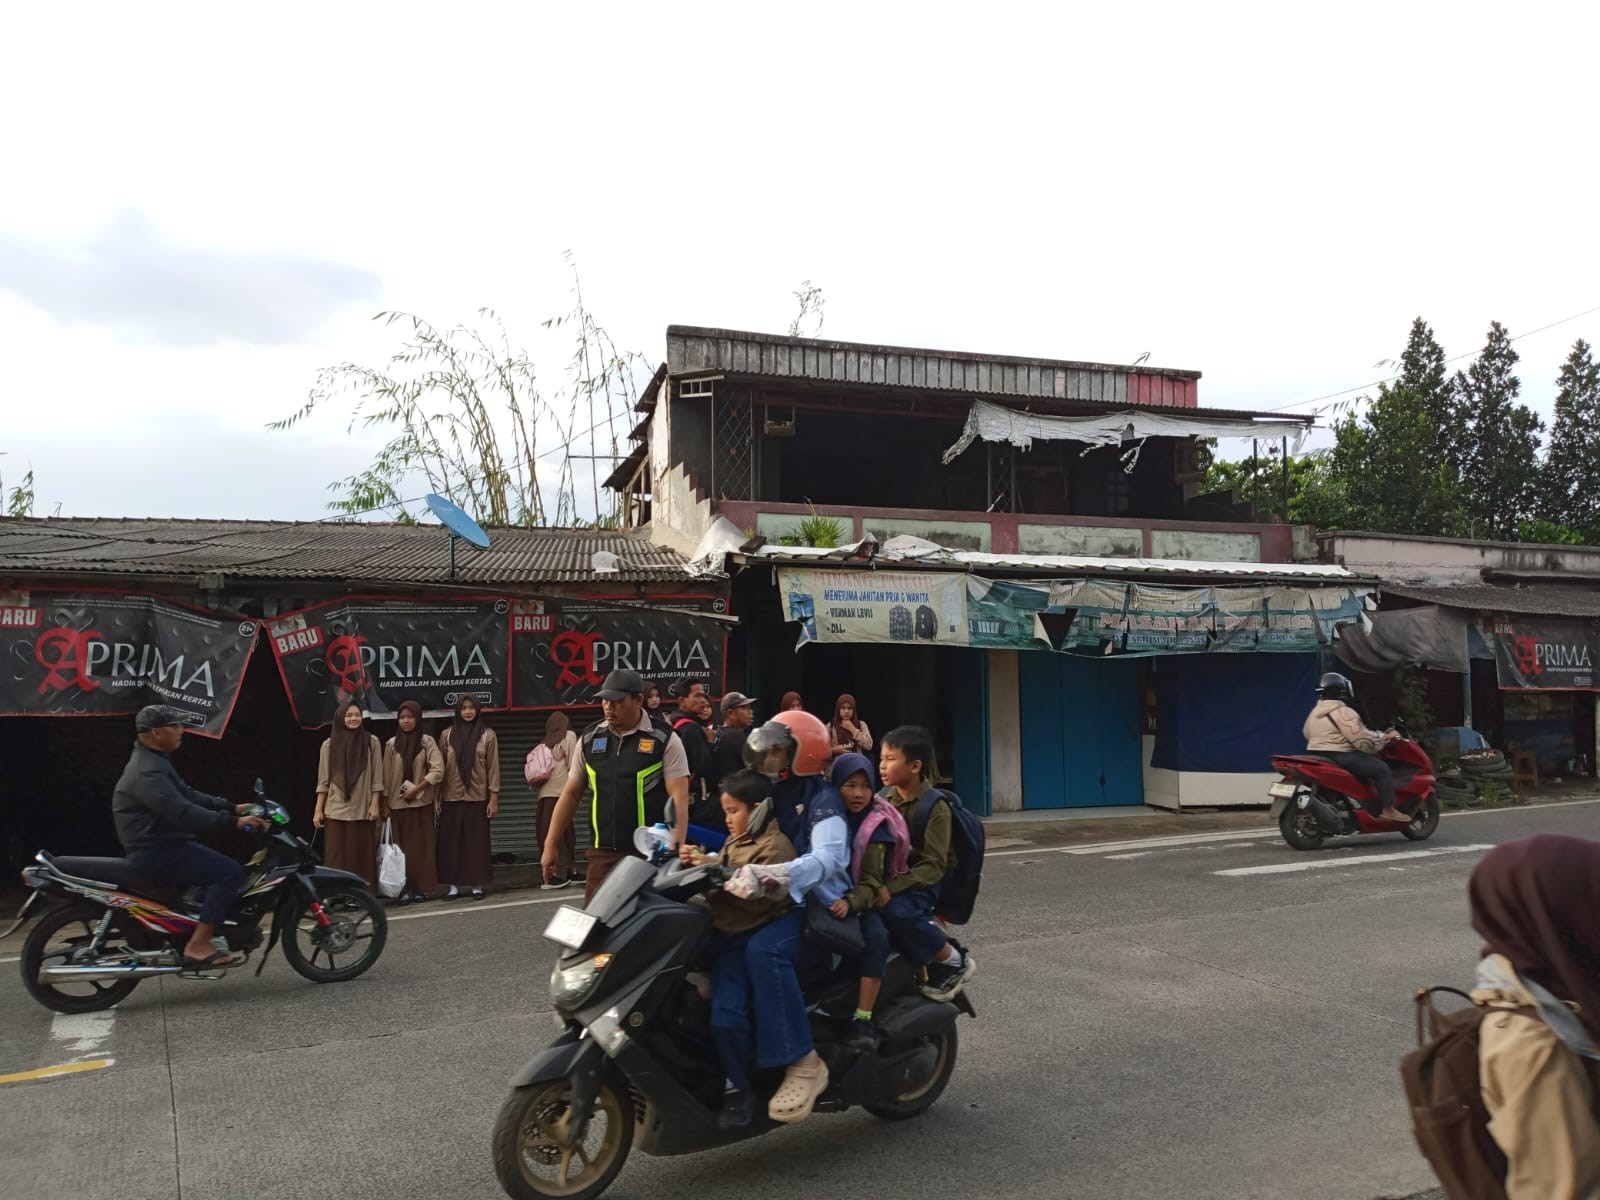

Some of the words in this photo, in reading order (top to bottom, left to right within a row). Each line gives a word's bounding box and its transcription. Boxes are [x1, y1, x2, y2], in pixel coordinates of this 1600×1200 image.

[823, 589, 858, 602] MENERIMA
[859, 591, 885, 603] JAHITAN
[885, 592, 899, 603] PRIA
[905, 592, 929, 603] WANITA
[0, 608, 37, 625] ARU
[514, 616, 550, 631] BARU
[276, 628, 318, 654] BARU
[657, 671, 686, 679] KEMASAN
[686, 670, 711, 678] KERTAS
[380, 680, 403, 688] HADIR
[430, 679, 464, 687] KEMASAN
[465, 678, 492, 686] KERTAS
[111, 679, 136, 687] HADIR
[182, 694, 213, 707] KERTAS
